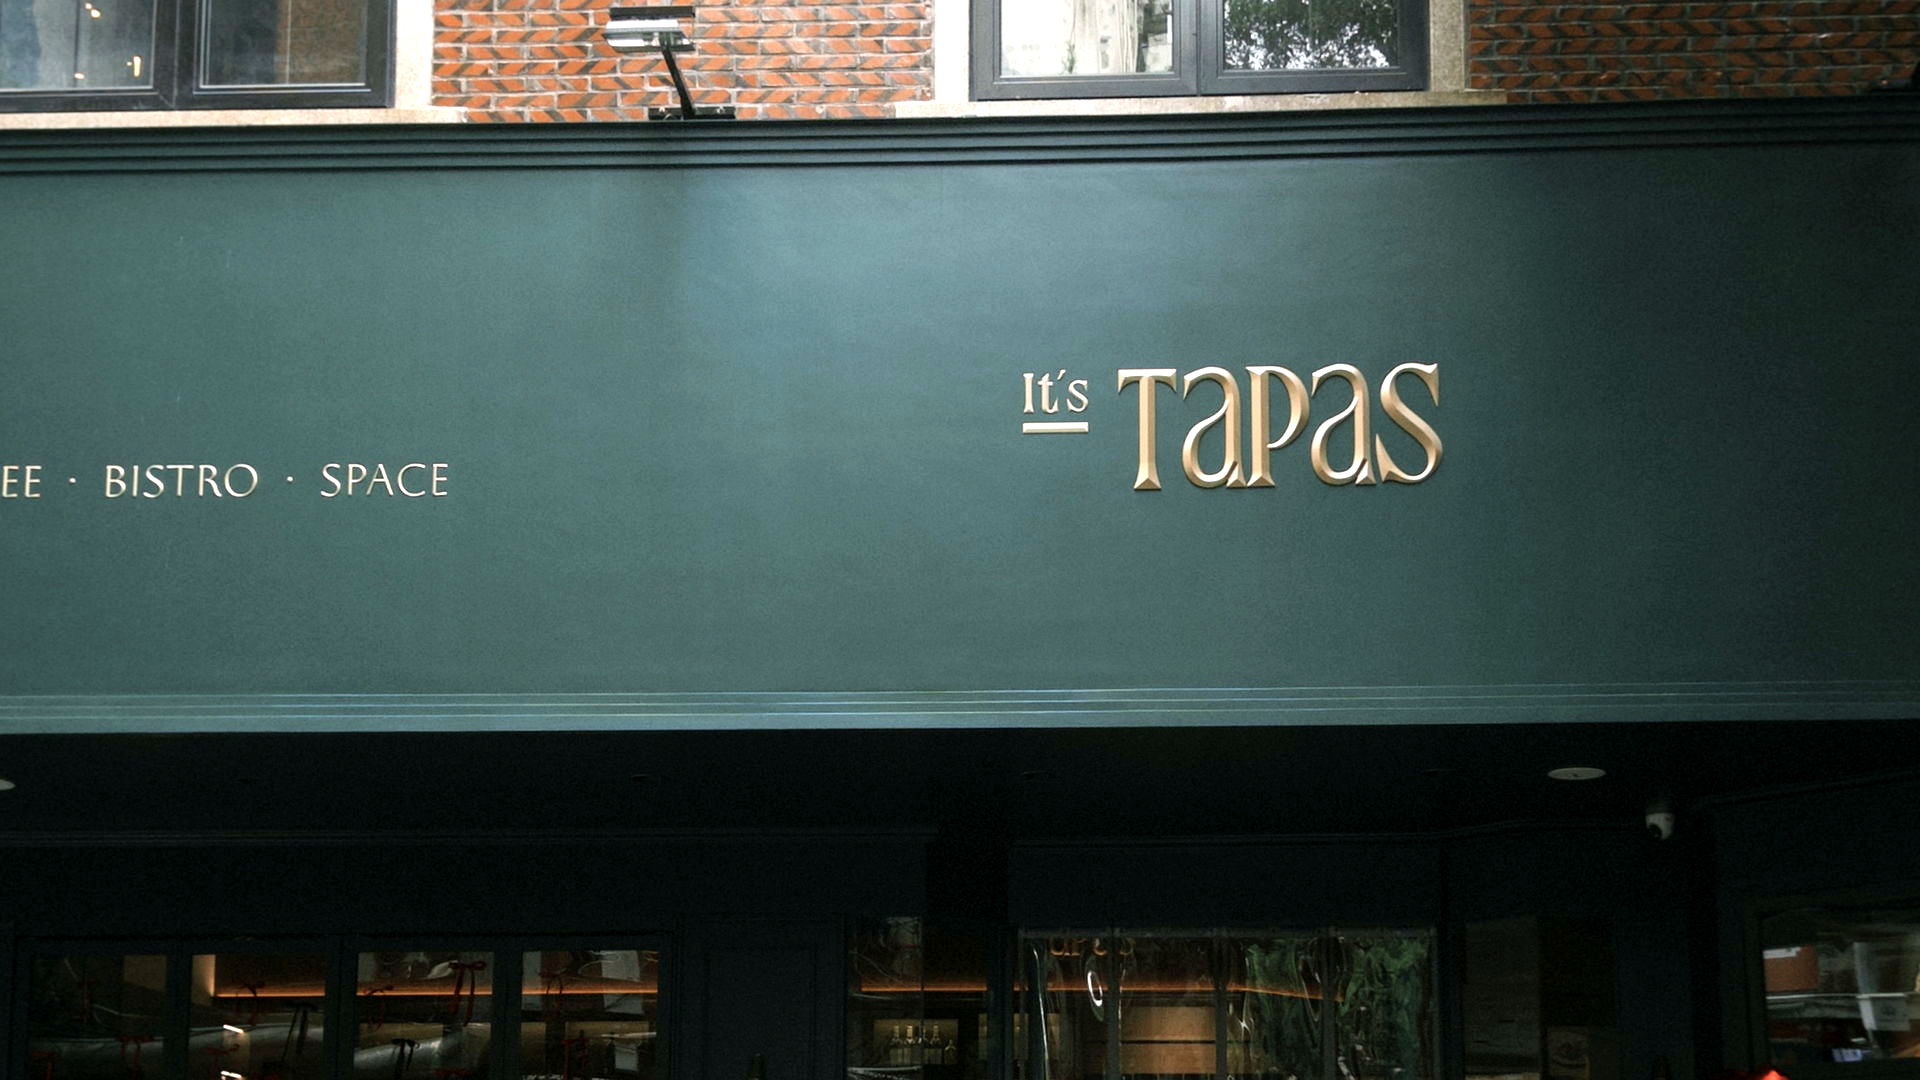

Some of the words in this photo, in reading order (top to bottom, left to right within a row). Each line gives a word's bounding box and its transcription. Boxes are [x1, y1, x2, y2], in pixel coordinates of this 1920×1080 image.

[1022, 368, 1089, 414] It's
[105, 463, 259, 498] BISTRO
[319, 462, 449, 498] SPACE
